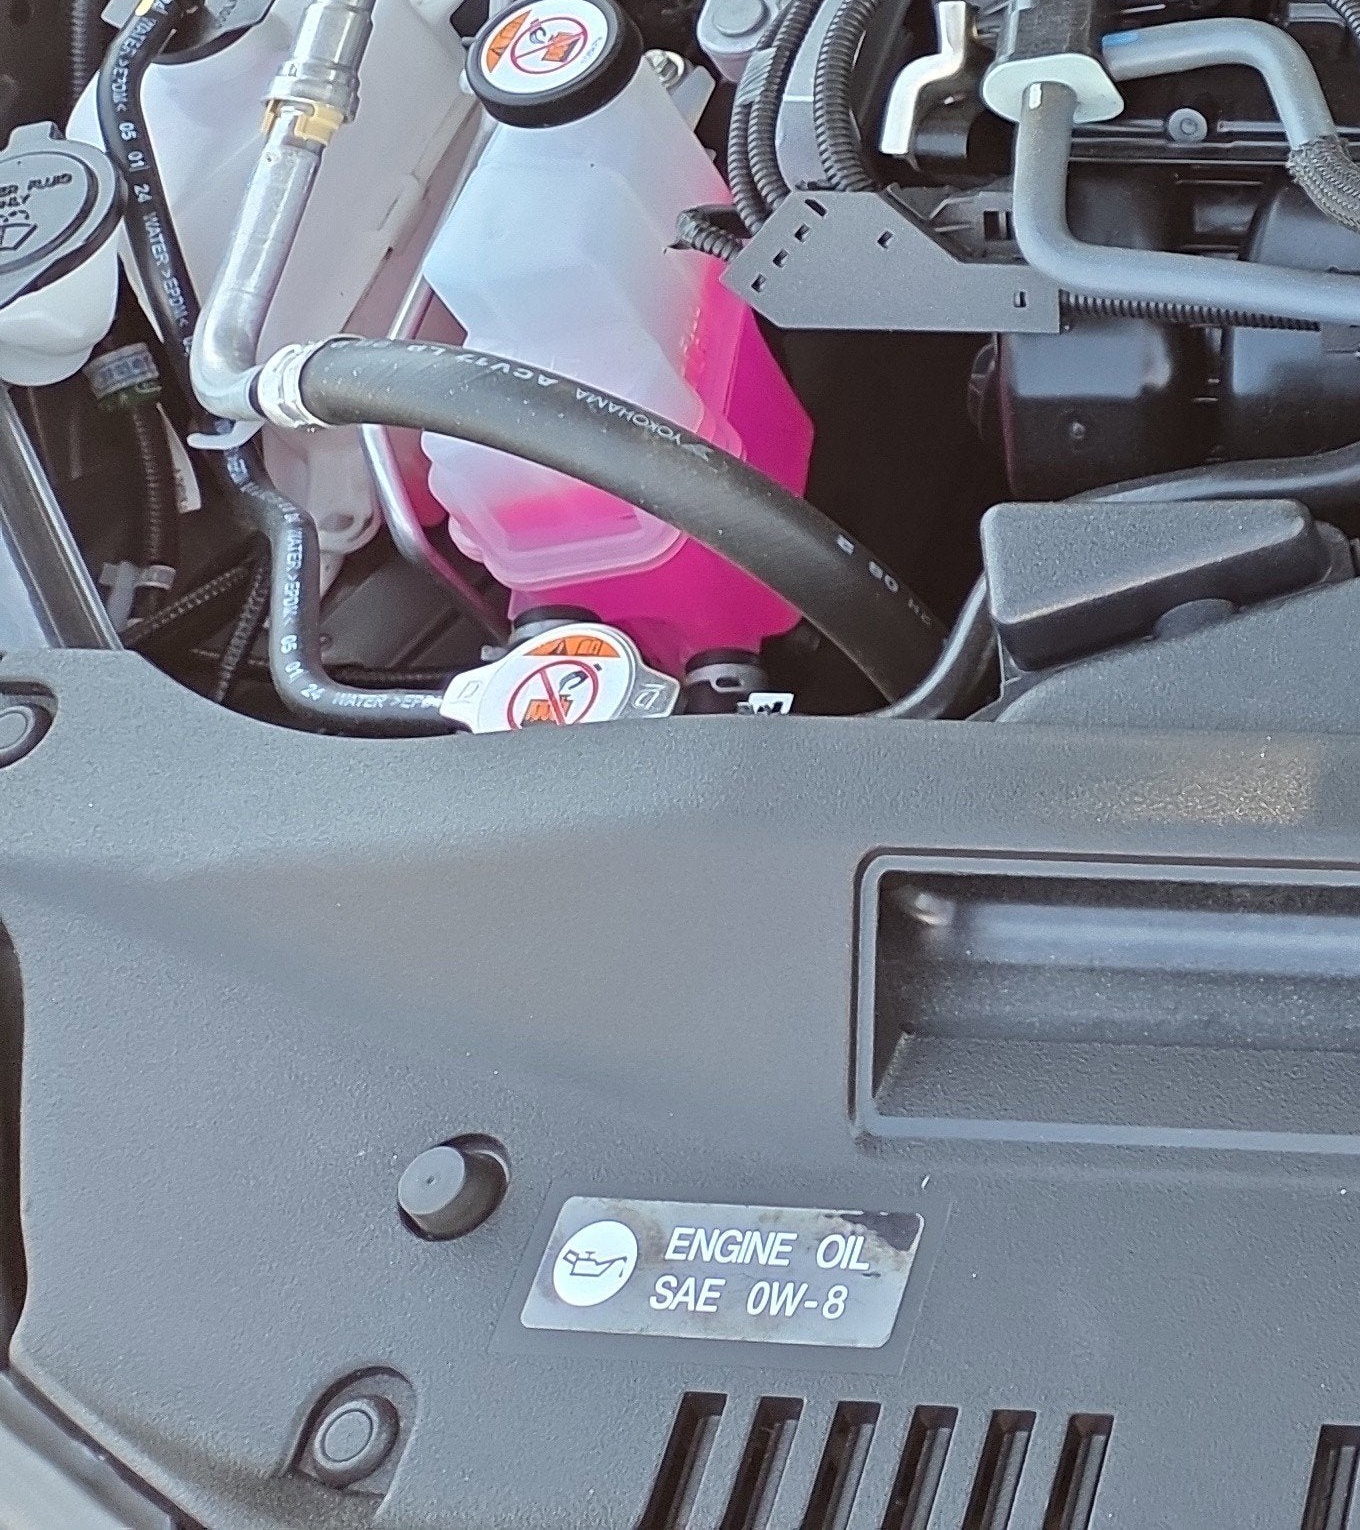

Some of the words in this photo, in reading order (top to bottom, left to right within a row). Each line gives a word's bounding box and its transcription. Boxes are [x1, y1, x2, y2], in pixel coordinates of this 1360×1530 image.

[119, 122, 138, 141] 05
[133, 183, 153, 203] 24
[576, 387, 682, 446] YOKOHAMA
[280, 635, 297, 654] 05
[664, 1227, 798, 1267] ENGINE
[816, 1234, 871, 1271] OIL
[649, 1274, 726, 1313] SAE
[746, 1280, 849, 1320] 0W-8
